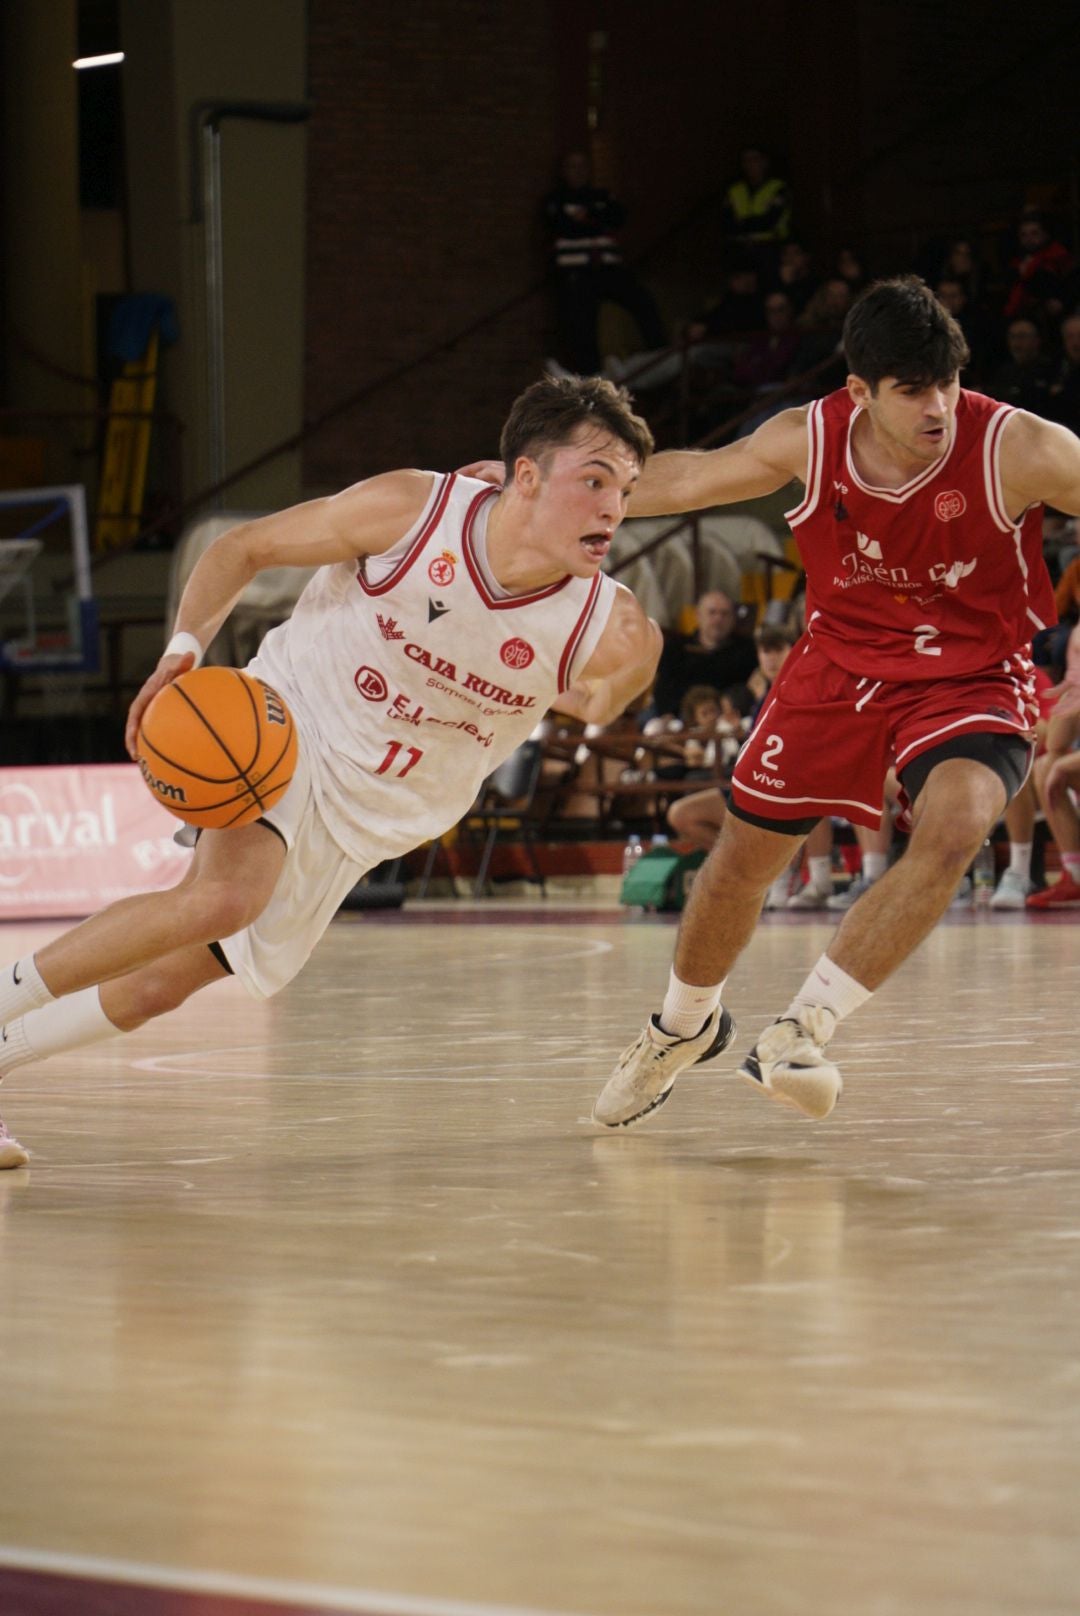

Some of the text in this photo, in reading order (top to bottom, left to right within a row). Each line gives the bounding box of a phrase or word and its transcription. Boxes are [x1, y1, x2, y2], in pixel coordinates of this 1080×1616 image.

[841, 552, 908, 582] Jaén
[876, 580, 923, 589] TERIOR
[912, 624, 942, 657] 2
[403, 643, 536, 708] CAJA RURAL
[374, 740, 425, 779] 11
[760, 734, 784, 771] 2
[752, 770, 786, 789] vive
